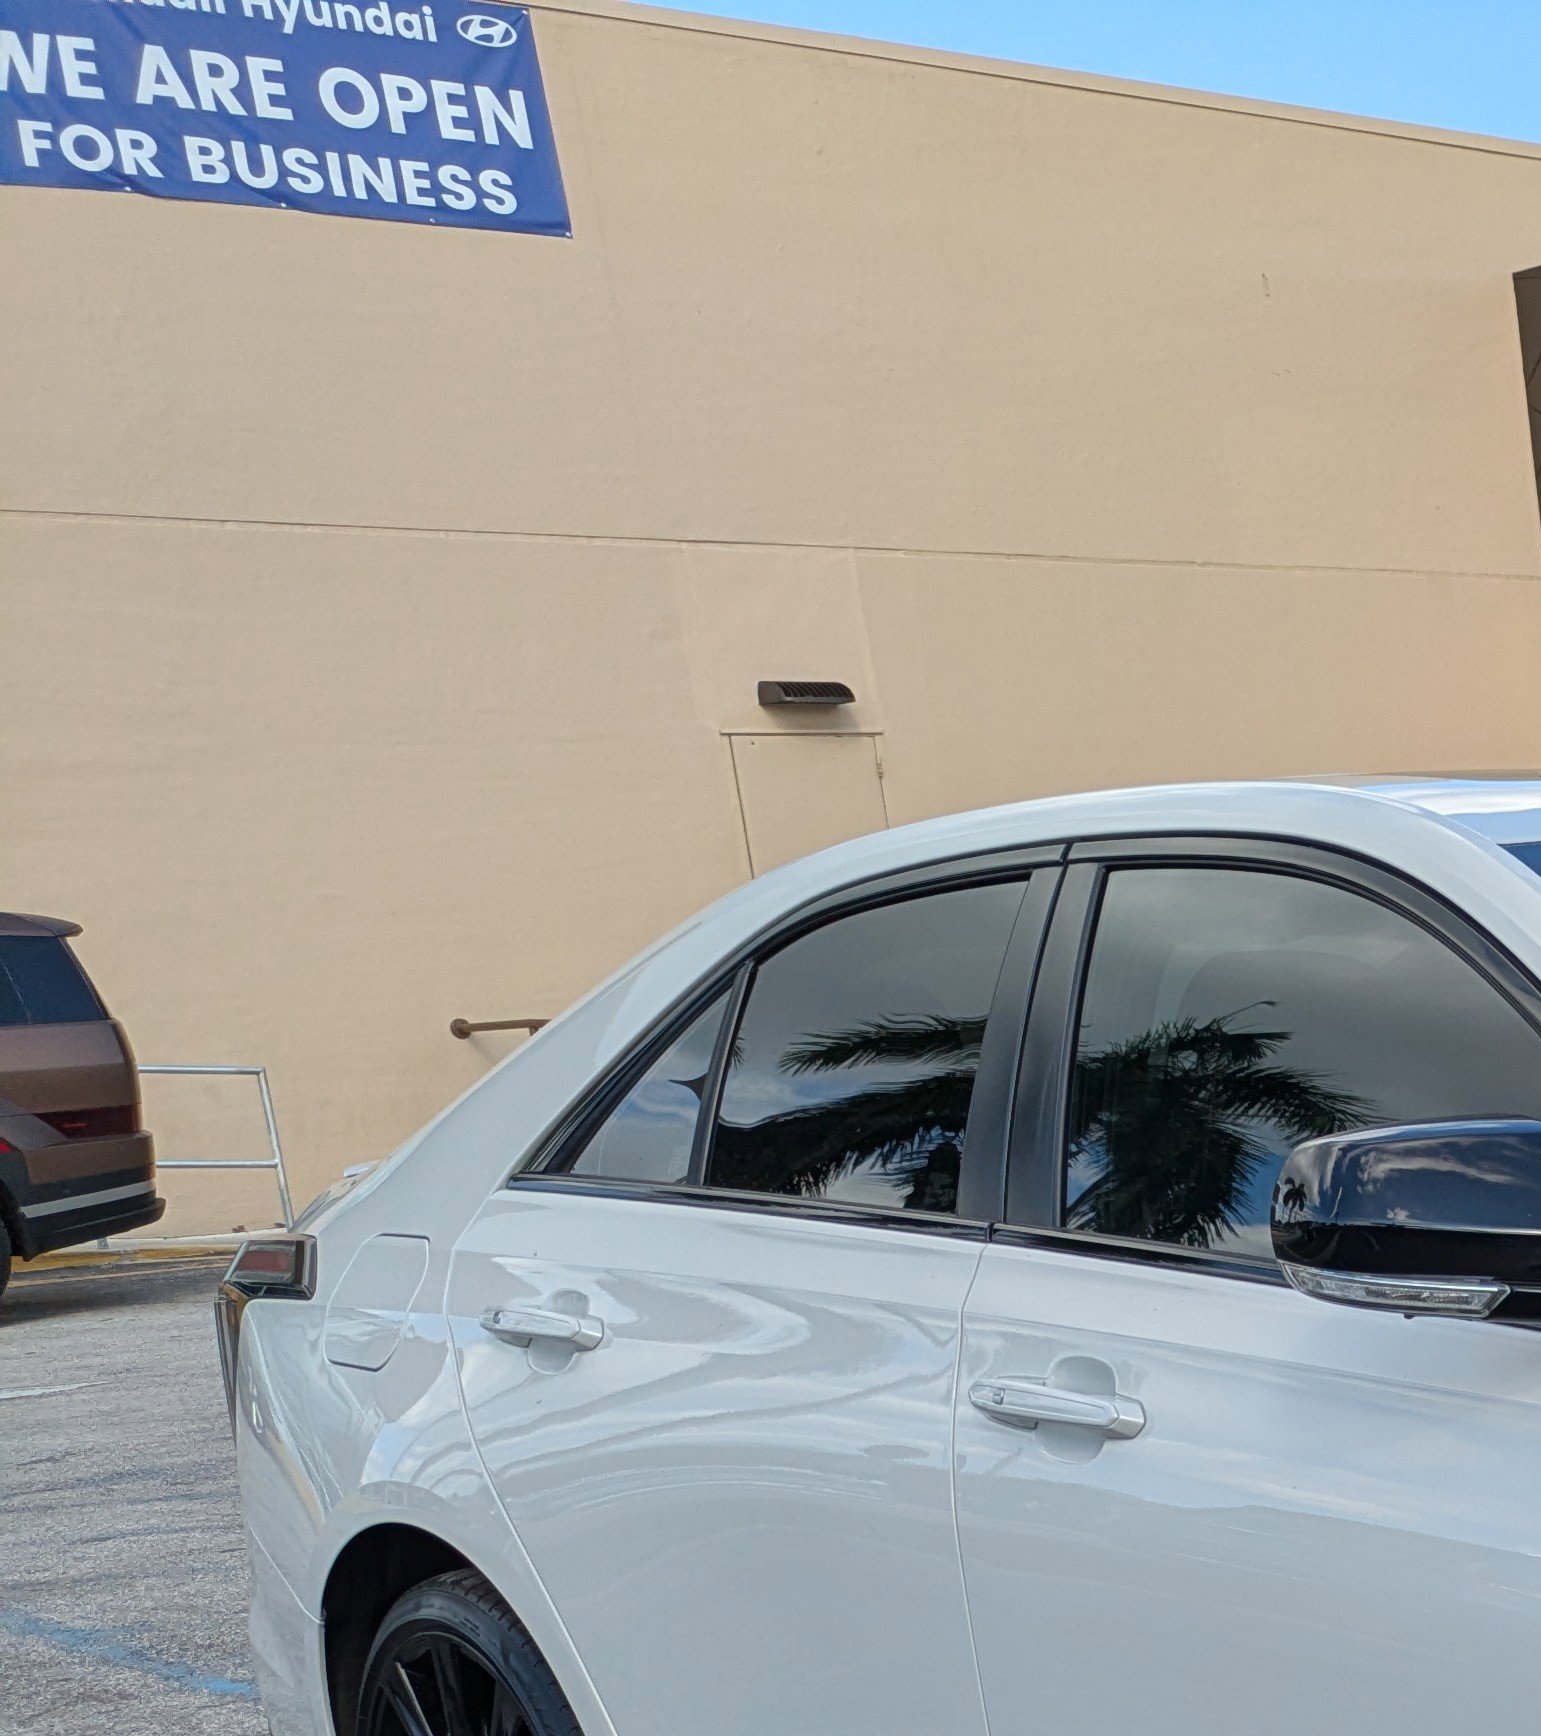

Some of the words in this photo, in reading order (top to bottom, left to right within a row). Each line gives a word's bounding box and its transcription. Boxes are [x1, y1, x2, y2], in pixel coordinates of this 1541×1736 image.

[136, 44, 294, 121] ARE
[318, 66, 535, 150] OPEN
[17, 119, 164, 178] FOR
[183, 136, 518, 215] BUSINESS
